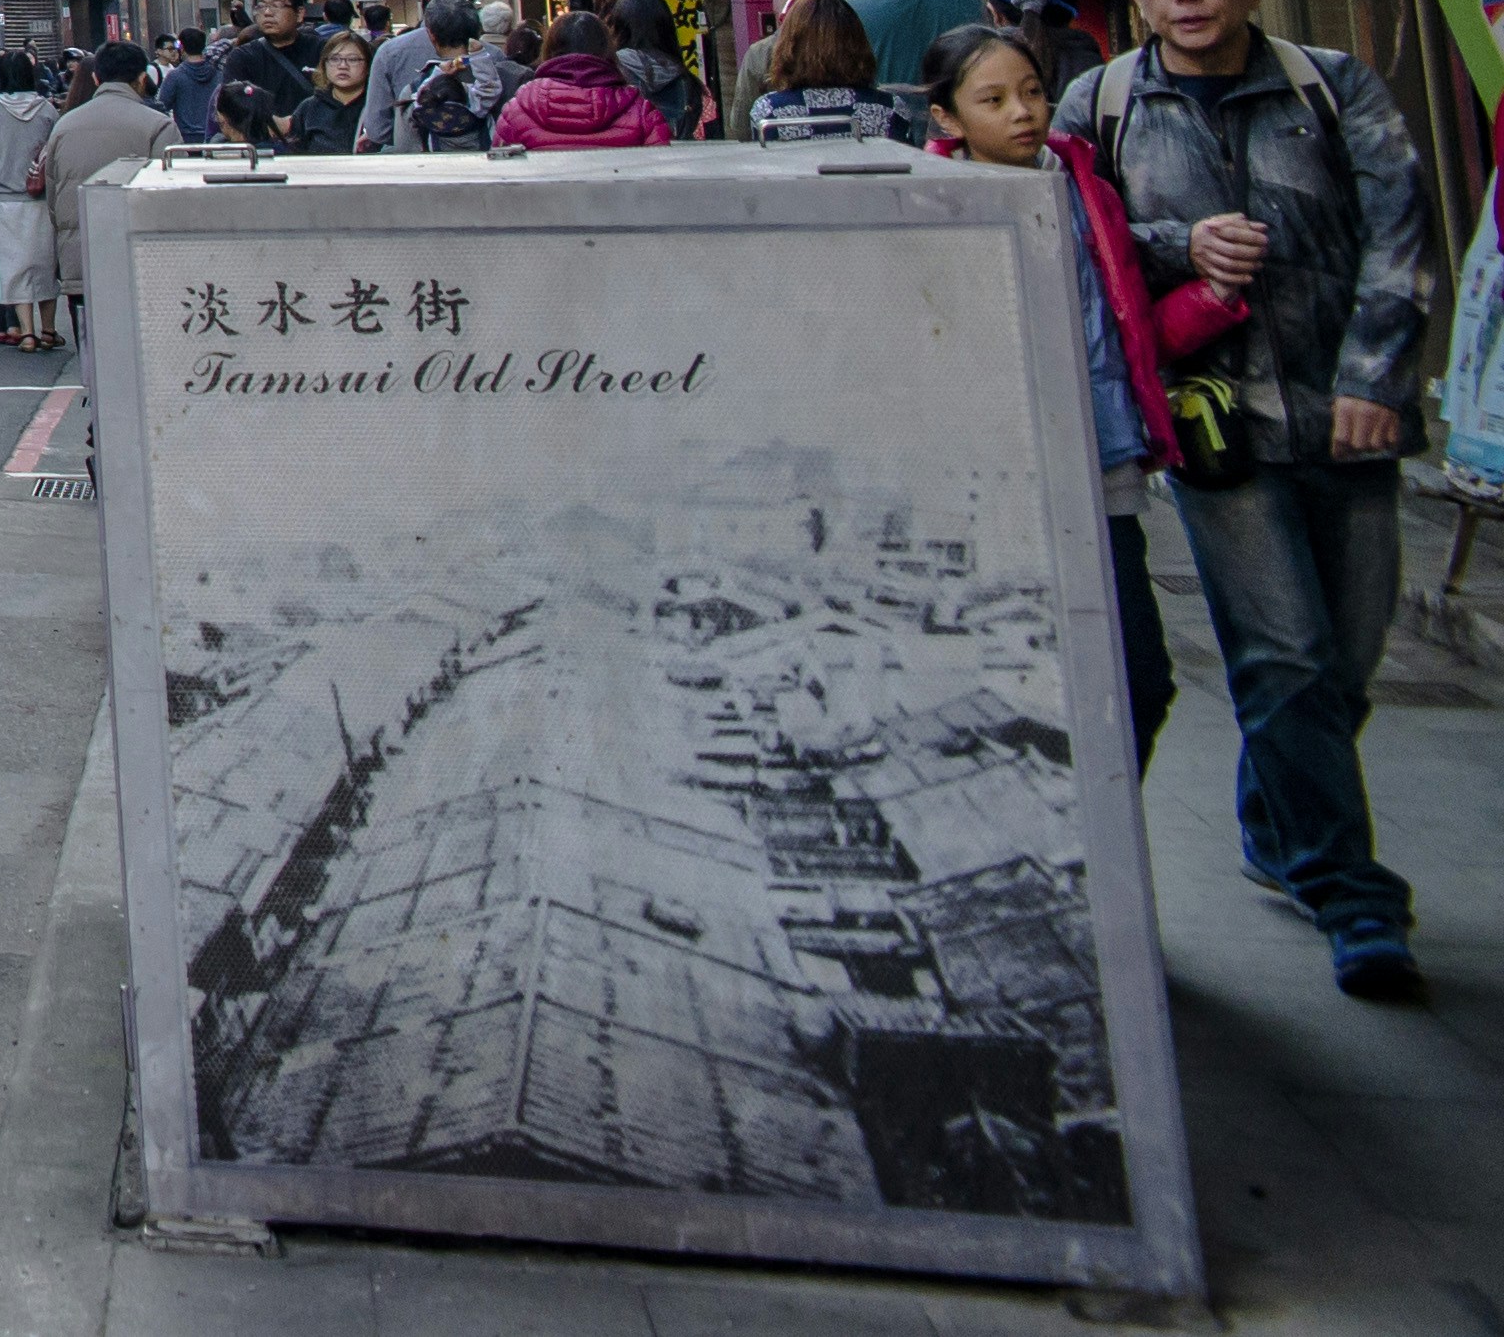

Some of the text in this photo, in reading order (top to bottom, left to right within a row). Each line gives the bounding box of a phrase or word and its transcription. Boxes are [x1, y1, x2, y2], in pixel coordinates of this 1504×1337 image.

[180, 277, 472, 338] 淡水老街
[182, 349, 714, 397] Tamsui Old Street
